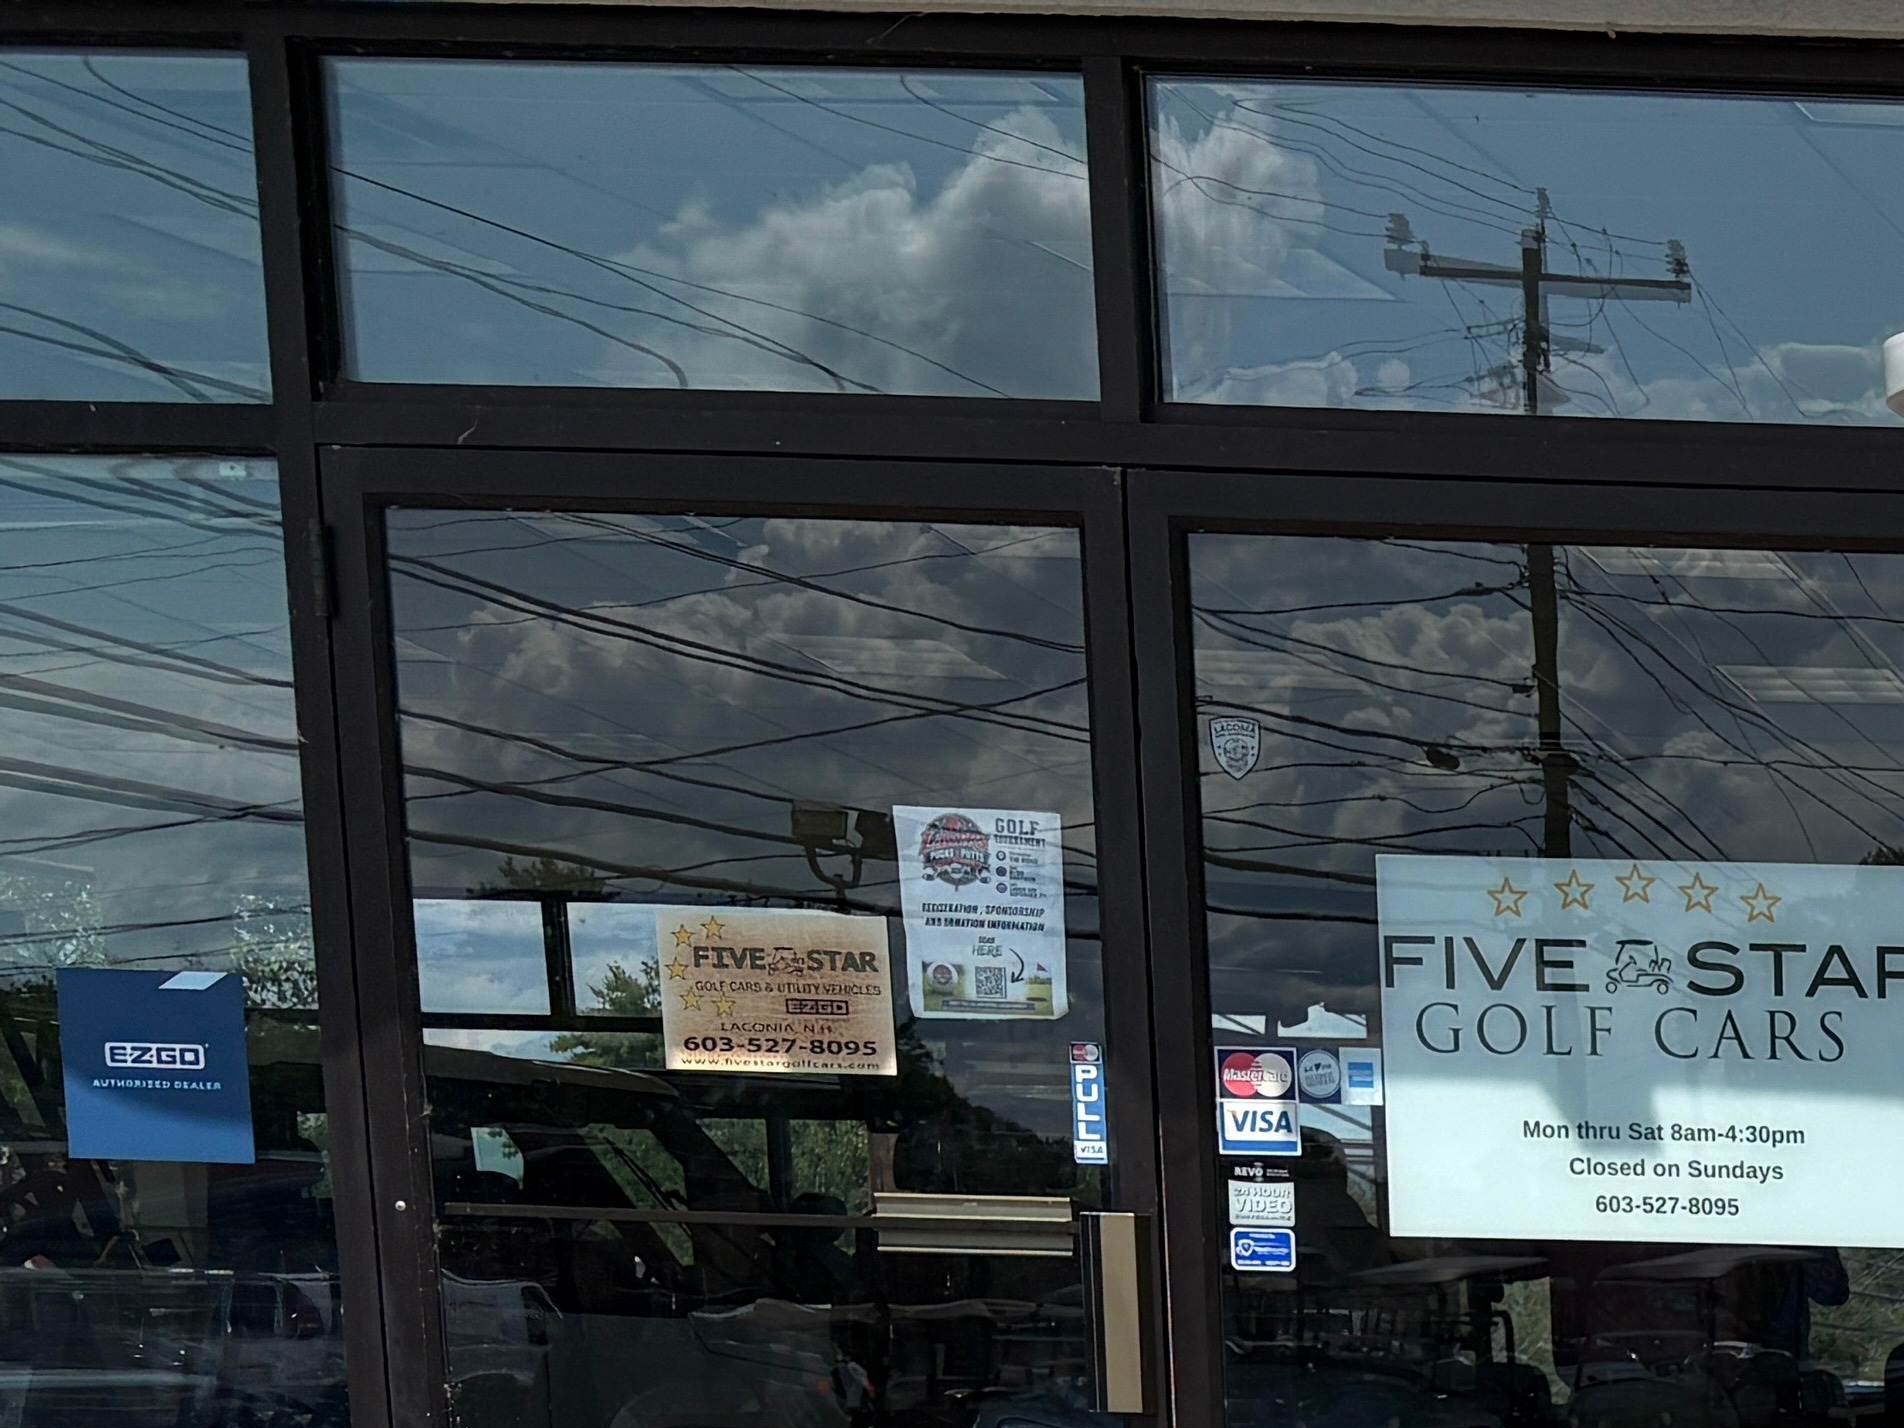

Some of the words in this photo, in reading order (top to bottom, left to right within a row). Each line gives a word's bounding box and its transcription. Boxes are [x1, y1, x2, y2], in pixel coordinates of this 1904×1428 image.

[995, 817, 1040, 836] GOLF
[987, 919, 1045, 931] INFORMATION
[692, 946, 767, 970] FIVE
[806, 951, 880, 973] STAR
[972, 944, 1003, 957] HERE
[1382, 935, 1591, 993] FIVE
[695, 981, 726, 992] GOLF
[729, 982, 762, 993] CARS
[765, 984, 773, 993] &
[777, 983, 821, 995] UTILITY
[823, 984, 881, 996] VEHICLES
[788, 1000, 847, 1014] EZGO
[1415, 1001, 1614, 1057] GOLF
[1653, 1006, 1846, 1063] CARS
[683, 1036, 878, 1056] 603-527-8095
[173, 1080, 221, 1091] DEALER
[1074, 1064, 1101, 1140] PULL
[1227, 1109, 1294, 1134] VISA
[1522, 1120, 1570, 1140] Mon
[1576, 1120, 1621, 1141] thru
[1628, 1122, 1664, 1142] Sat
[1670, 1122, 1806, 1148] 8am-4:30pm
[1080, 1145, 1104, 1154] VISA
[1568, 1157, 1646, 1177] Closed
[1653, 1163, 1680, 1178] on
[1687, 1159, 1785, 1184] Sundays
[1236, 1199, 1293, 1215] VIDEO
[1595, 1195, 1740, 1217] 603-527-8095
